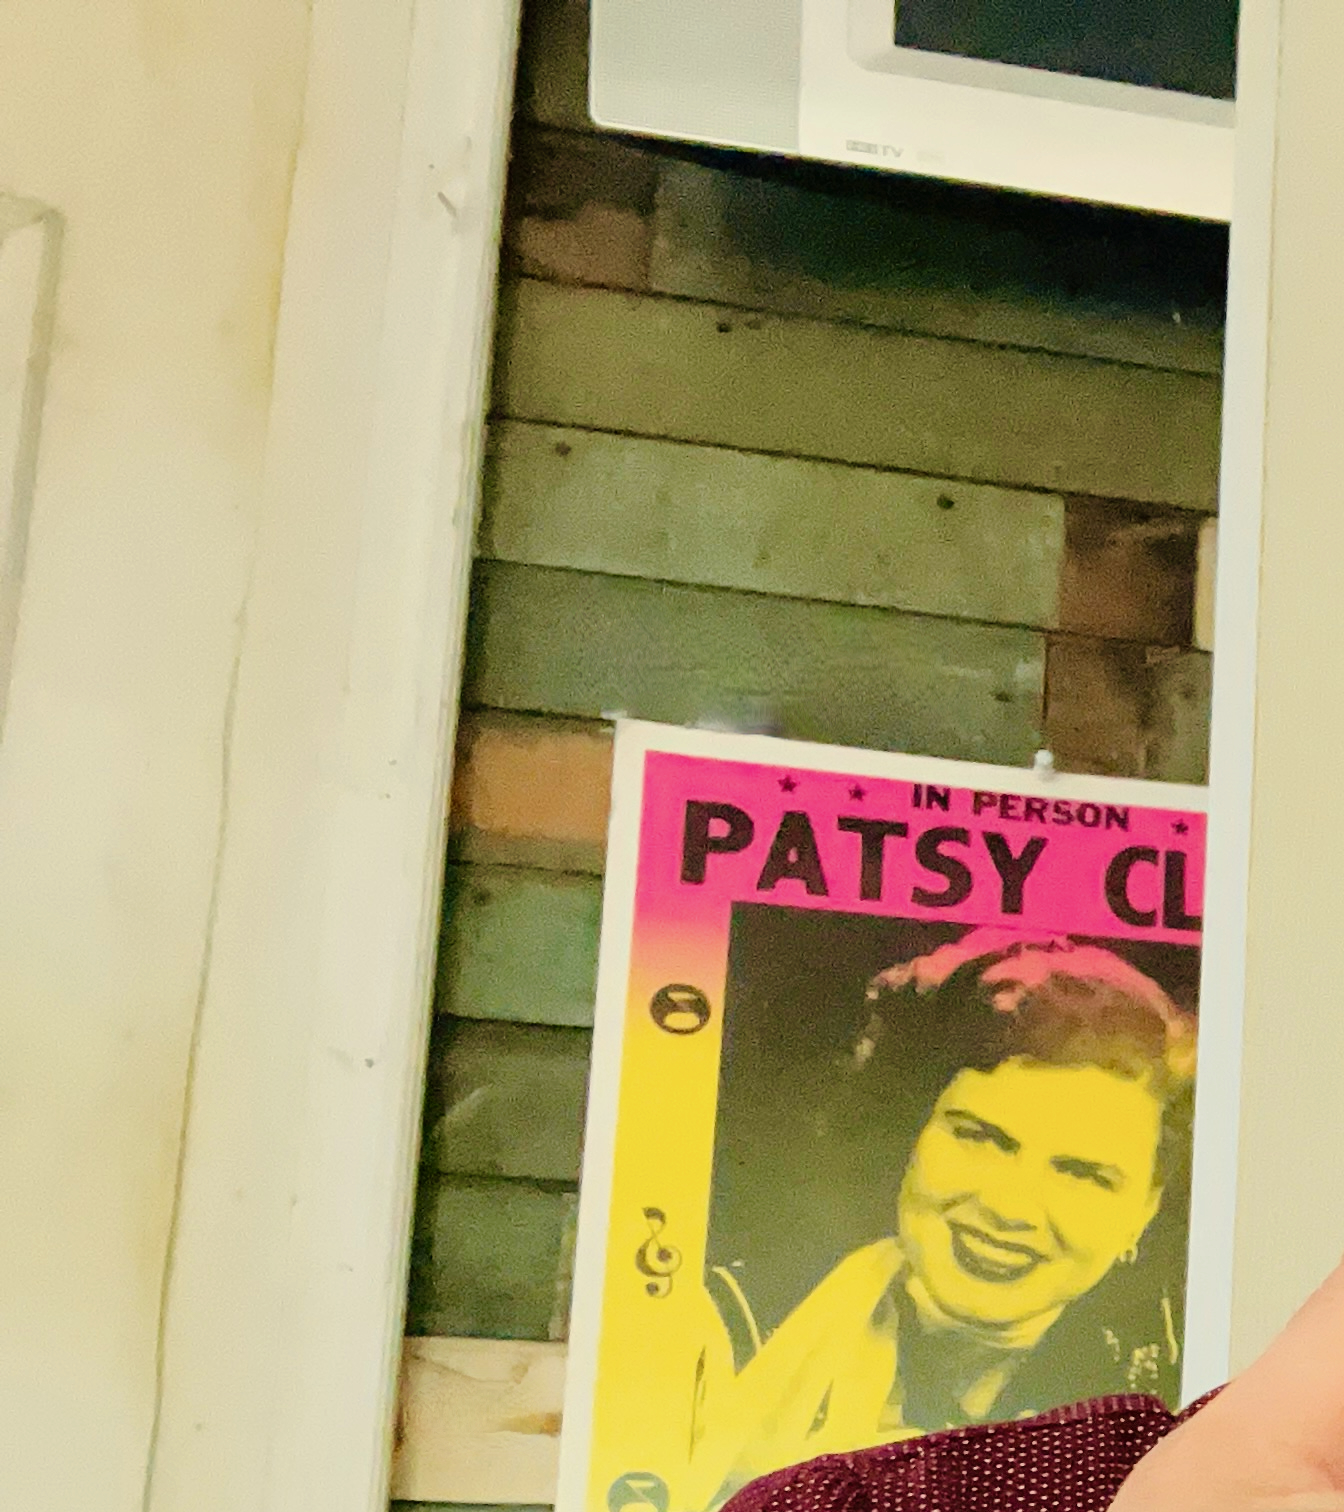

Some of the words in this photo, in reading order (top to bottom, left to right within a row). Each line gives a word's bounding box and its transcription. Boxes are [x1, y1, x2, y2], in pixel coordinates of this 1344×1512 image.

[912, 783, 951, 812] IN
[972, 790, 1129, 832] PERSON
[680, 799, 1048, 915] PATSY
